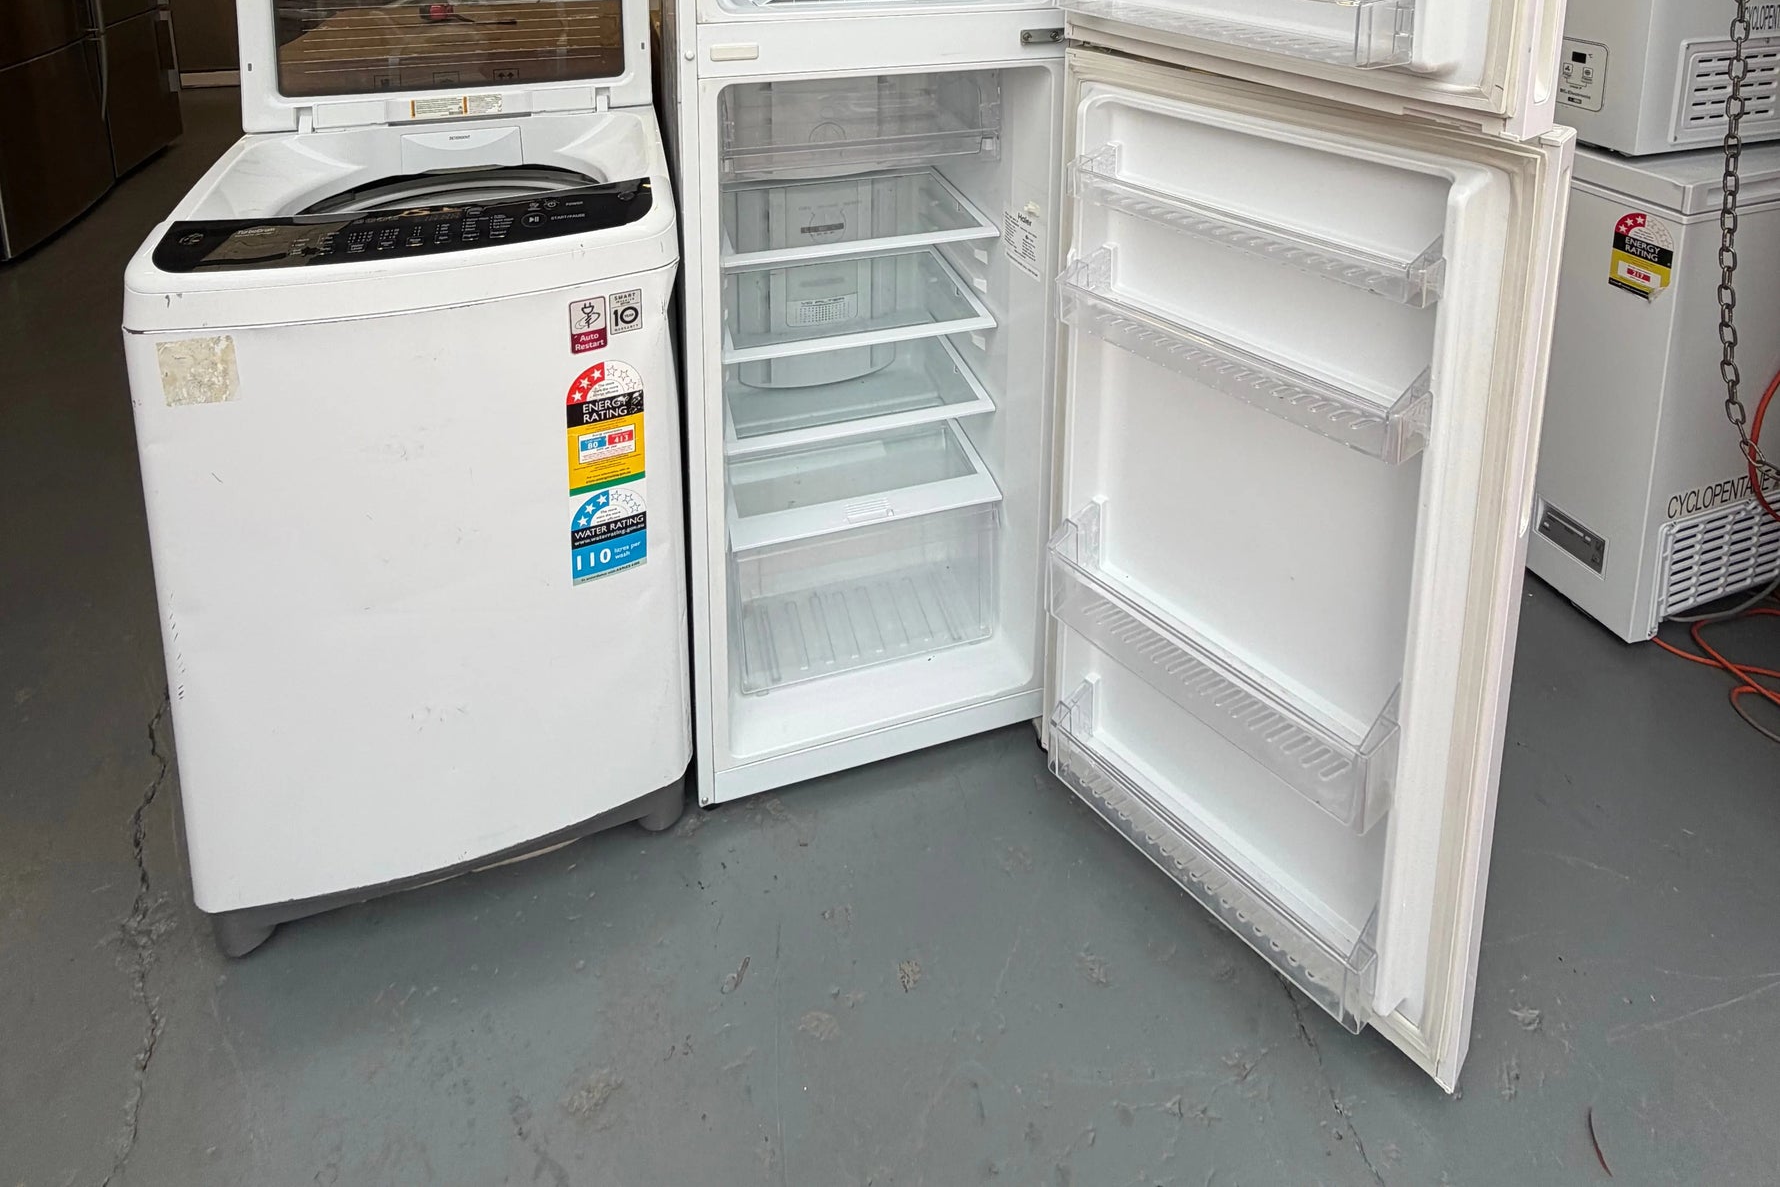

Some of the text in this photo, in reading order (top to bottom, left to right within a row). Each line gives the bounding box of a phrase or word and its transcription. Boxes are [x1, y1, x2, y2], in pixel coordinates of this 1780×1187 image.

[1624, 236, 1661, 254] ENERGY
[1625, 245, 1658, 262] RATING
[614, 292, 636, 301] SMART
[613, 306, 639, 327] 10
[575, 339, 605, 351] Restart
[580, 333, 599, 342] Auto
[583, 397, 627, 413] ENERGY
[583, 406, 628, 423] RATING
[587, 441, 598, 450] 80
[613, 434, 629, 443] 413
[1667, 468, 1771, 519] CYCLOPENTAE
[574, 525, 607, 540] WATER
[610, 514, 644, 531] RATING
[577, 548, 611, 571] 110
[615, 551, 630, 560] wash
